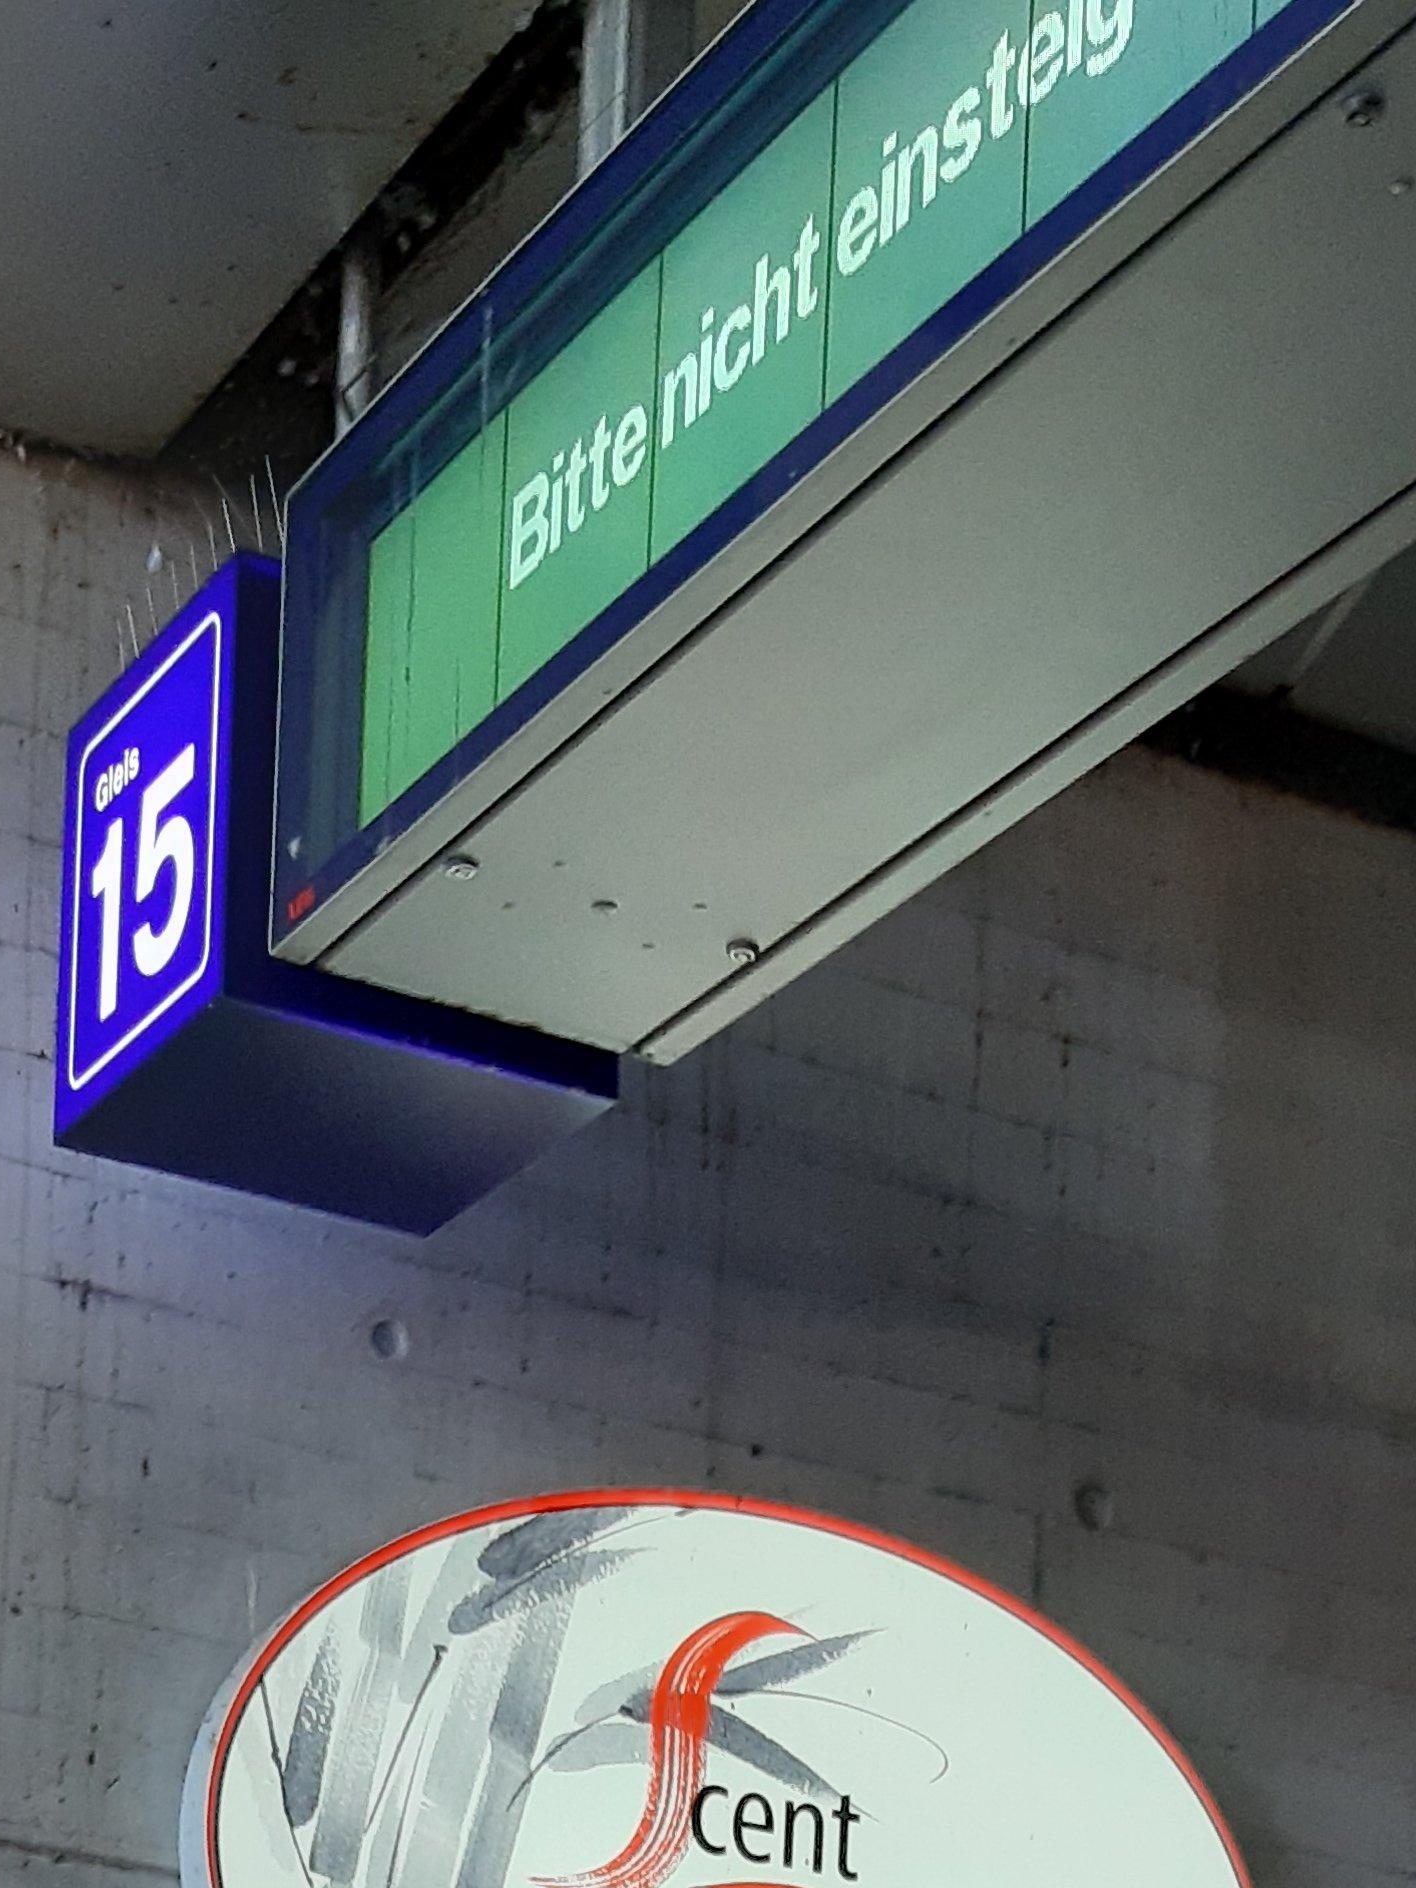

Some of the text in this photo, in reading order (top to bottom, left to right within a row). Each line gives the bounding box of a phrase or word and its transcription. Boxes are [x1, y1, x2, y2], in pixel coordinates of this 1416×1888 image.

[509, 401, 647, 590] Bitte
[660, 213, 823, 449] nicht
[91, 742, 196, 1023] 15
[95, 746, 140, 813] Gleis
